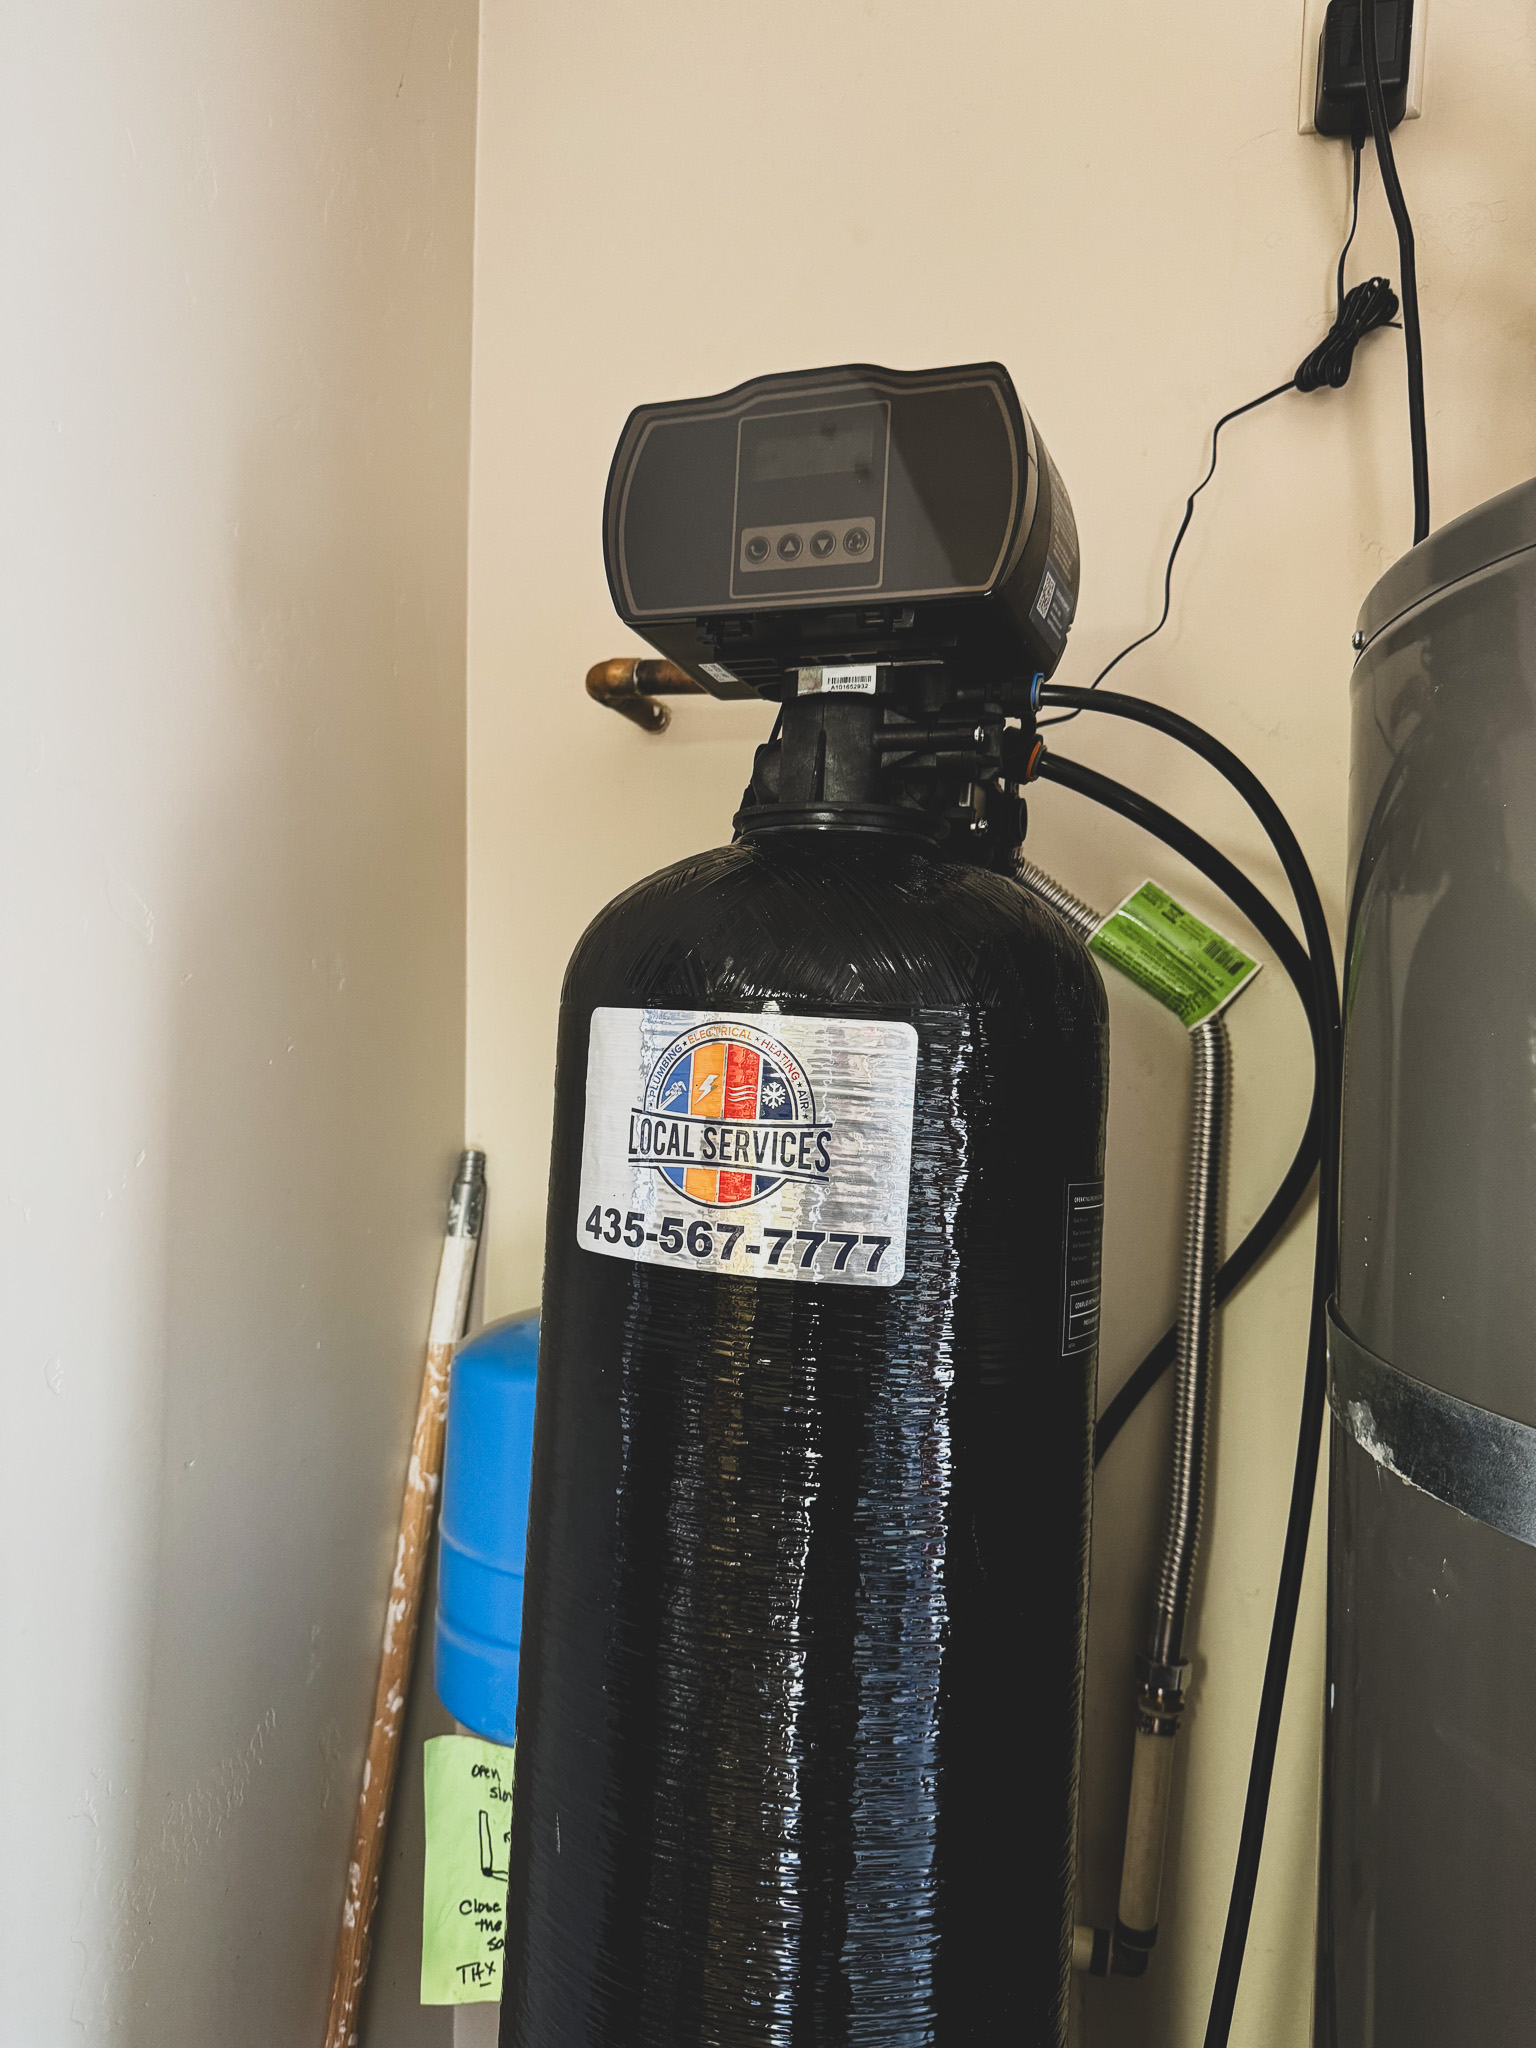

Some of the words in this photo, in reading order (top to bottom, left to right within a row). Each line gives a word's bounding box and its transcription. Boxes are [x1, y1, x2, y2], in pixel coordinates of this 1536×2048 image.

[650, 1044, 683, 1099] PLUMBING
[687, 1026, 752, 1045] ELECTRICAL
[761, 1038, 800, 1081] HEATING
[797, 1089, 811, 1110] AIR
[628, 1114, 695, 1157] LOCAL
[702, 1126, 831, 1173] SERVICES
[585, 1204, 893, 1273] 435-567-7777
[474, 1918, 503, 1933] the
